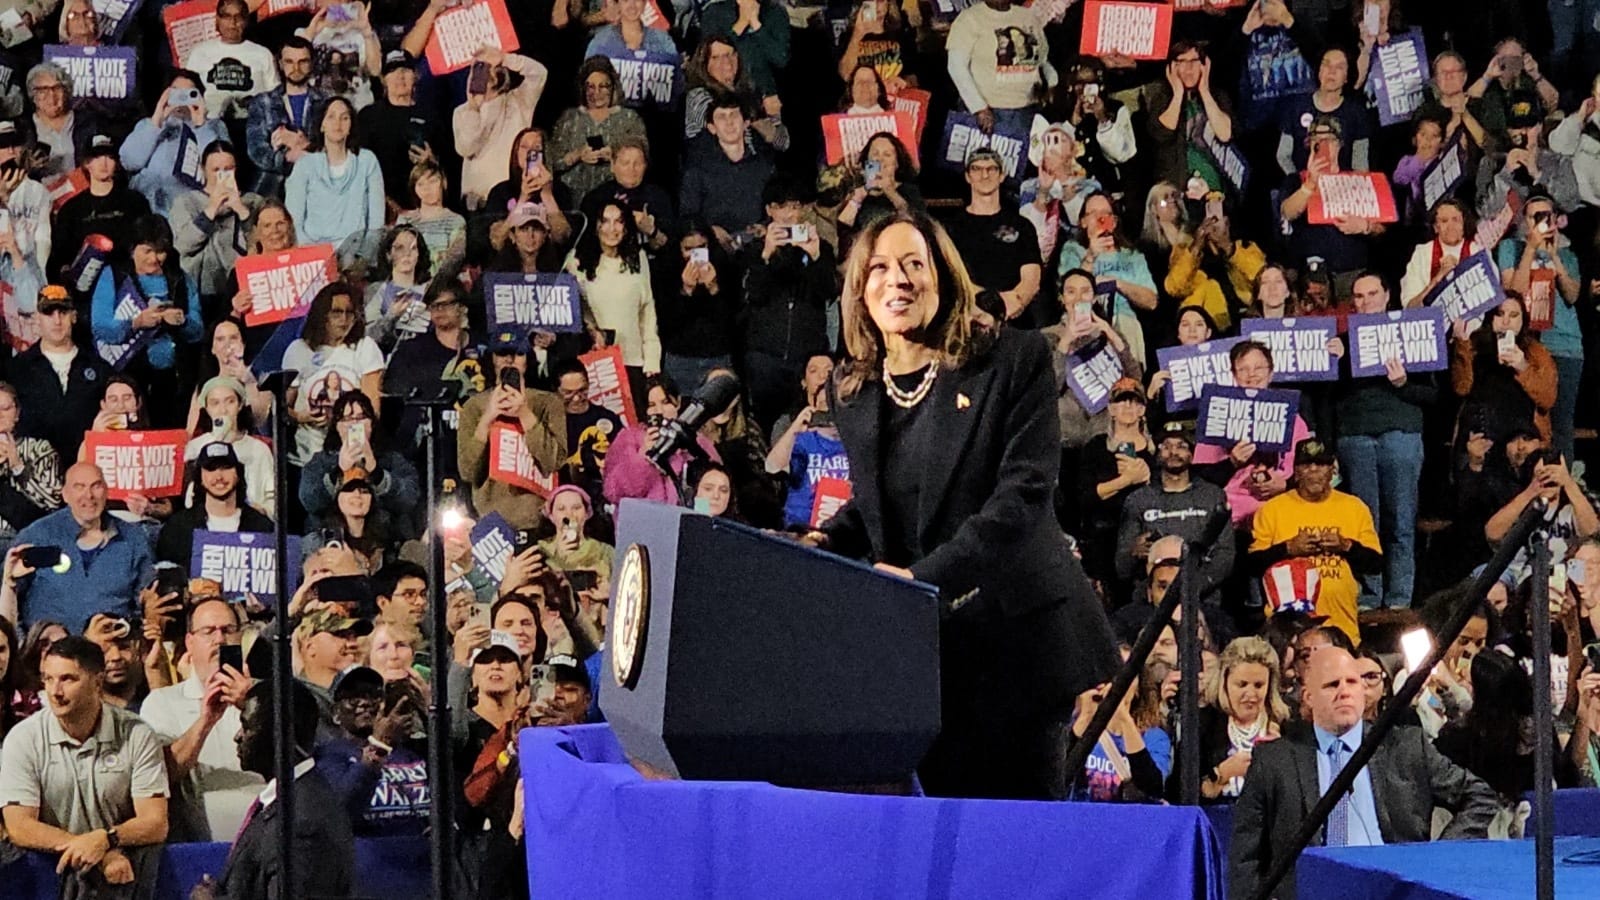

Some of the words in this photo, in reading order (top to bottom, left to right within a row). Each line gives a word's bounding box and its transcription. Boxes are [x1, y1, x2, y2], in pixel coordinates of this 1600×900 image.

[1100, 4, 1157, 24] FREEDOM
[1098, 20, 1156, 40] FREEDOM
[1096, 36, 1155, 56] FREEDOM
[1396, 40, 1420, 73] WIN
[70, 57, 93, 78] WE
[94, 58, 127, 78] VOTE
[620, 60, 642, 81] WE
[643, 62, 676, 83] VOTE
[1378, 44, 1402, 77] VOTE
[94, 77, 127, 99] WIN
[642, 81, 674, 103] WIN
[1385, 75, 1405, 98] WE
[839, 114, 897, 137] FREEDOM
[990, 133, 1023, 158] VOTE
[1324, 203, 1380, 219] FREEDOM
[266, 266, 290, 288] WE
[290, 259, 329, 287] VOTE
[1455, 262, 1489, 293] VOTE
[247, 271, 274, 315] WHEN
[270, 285, 297, 310] WE
[493, 284, 515, 324] WHEN
[513, 285, 536, 304] WE
[536, 285, 571, 305] VOTE
[1462, 280, 1496, 311] WIN
[514, 303, 540, 326] WE
[538, 304, 574, 326] WIN
[1270, 330, 1294, 351] WE
[1293, 329, 1330, 351] VOTE
[1377, 322, 1400, 343] WE
[1400, 319, 1437, 341] VOTE
[1358, 325, 1380, 369] WHEN
[1402, 340, 1438, 363] WIN
[595, 357, 620, 388] WIN
[1187, 355, 1213, 377] WE
[1210, 351, 1232, 374] VO
[1271, 350, 1297, 373] WE
[1296, 350, 1330, 373] WIN
[1072, 363, 1107, 404] WHEN
[1168, 358, 1193, 402] WHEN
[1205, 395, 1230, 437] WHEN
[1229, 398, 1253, 421] WE
[1253, 400, 1290, 422] VOTE
[1226, 418, 1253, 443] WE
[1252, 420, 1287, 444] WIN
[117, 446, 141, 467] WE
[142, 444, 177, 467] VOTE
[499, 427, 519, 473] WHEN
[117, 466, 143, 490] WE
[143, 463, 176, 489] WIN
[1143, 507, 1208, 521] Champion
[224, 545, 250, 569] WE
[472, 527, 509, 565] VOTE
[223, 567, 250, 593] WE
[251, 569, 276, 595] WI
